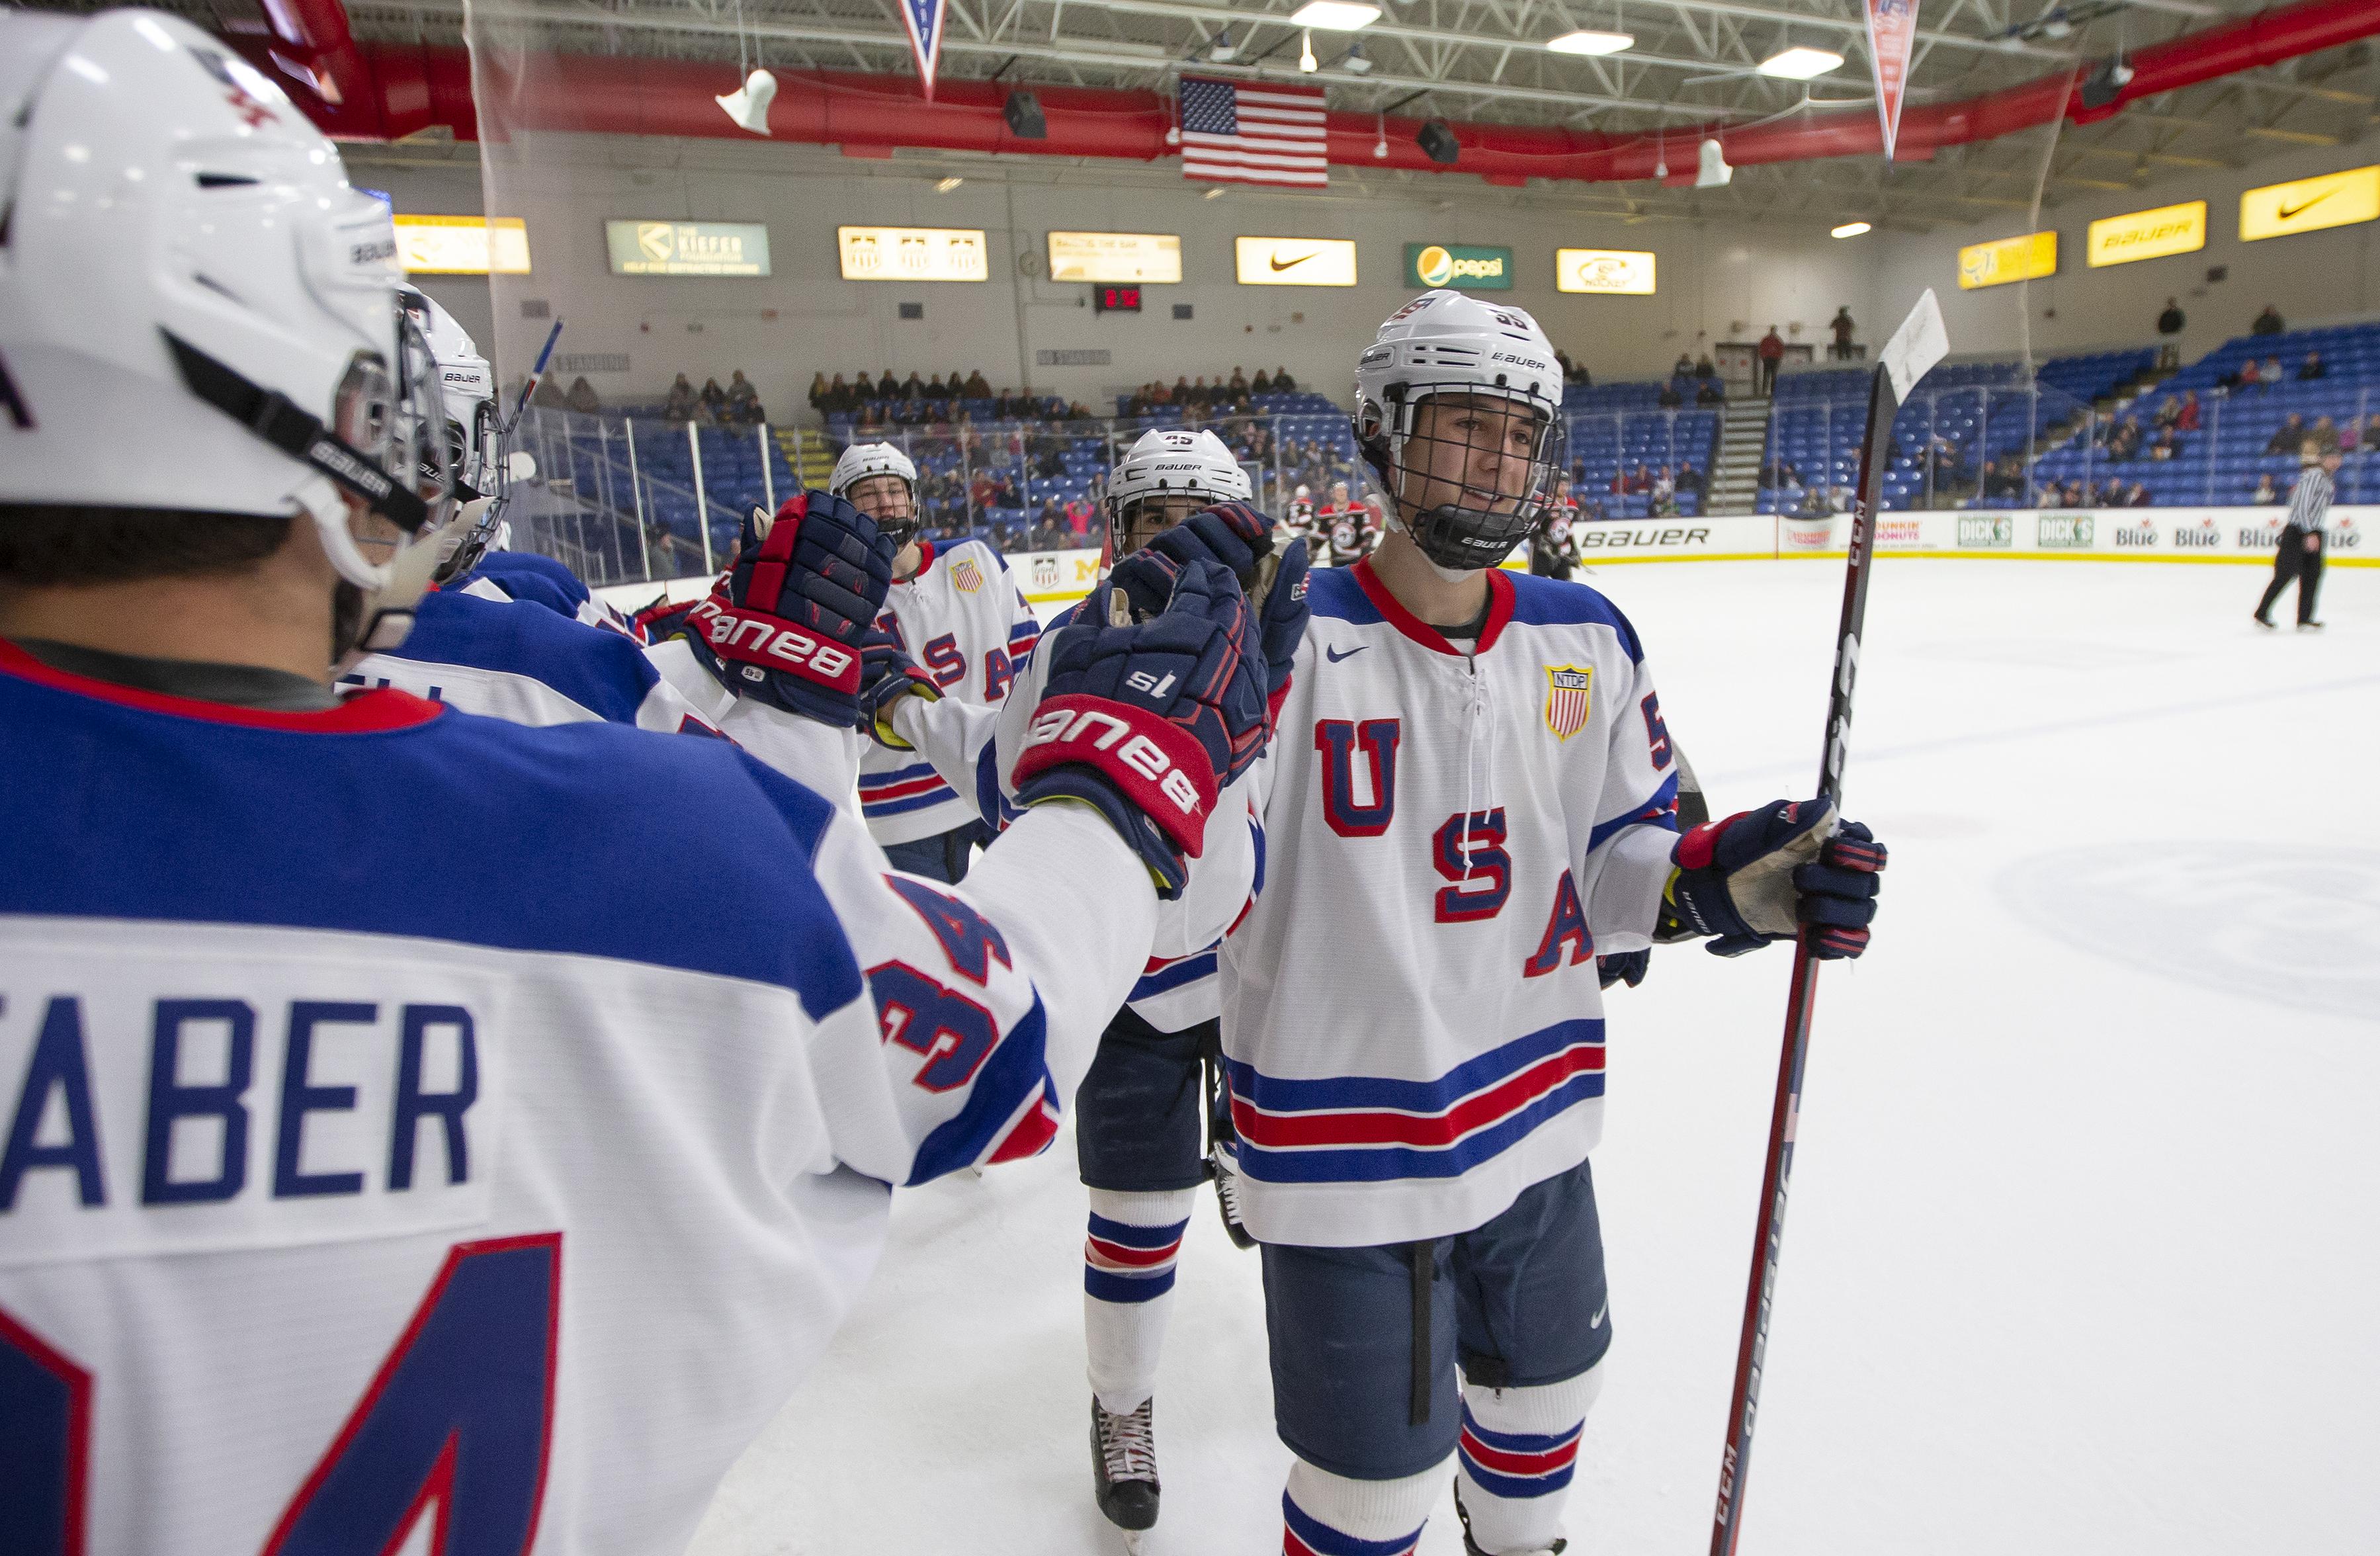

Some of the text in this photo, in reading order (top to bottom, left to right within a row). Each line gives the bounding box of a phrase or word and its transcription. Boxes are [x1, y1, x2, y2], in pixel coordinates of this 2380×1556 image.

[1453, 258, 1502, 278] pepsi
[1581, 529, 1711, 548] BAUER
[1849, 499, 1868, 567] CCM
[1960, 517, 2011, 541] DICK'S
[2041, 517, 2092, 541] DICK'S
[2116, 529, 2158, 547] Blue
[2175, 529, 2221, 547] Blue
[1074, 558, 1100, 582] M
[1556, 674, 1586, 687] NTDP
[0, 992, 481, 1215] ABER
[1715, 1441, 1738, 1526] CCM
